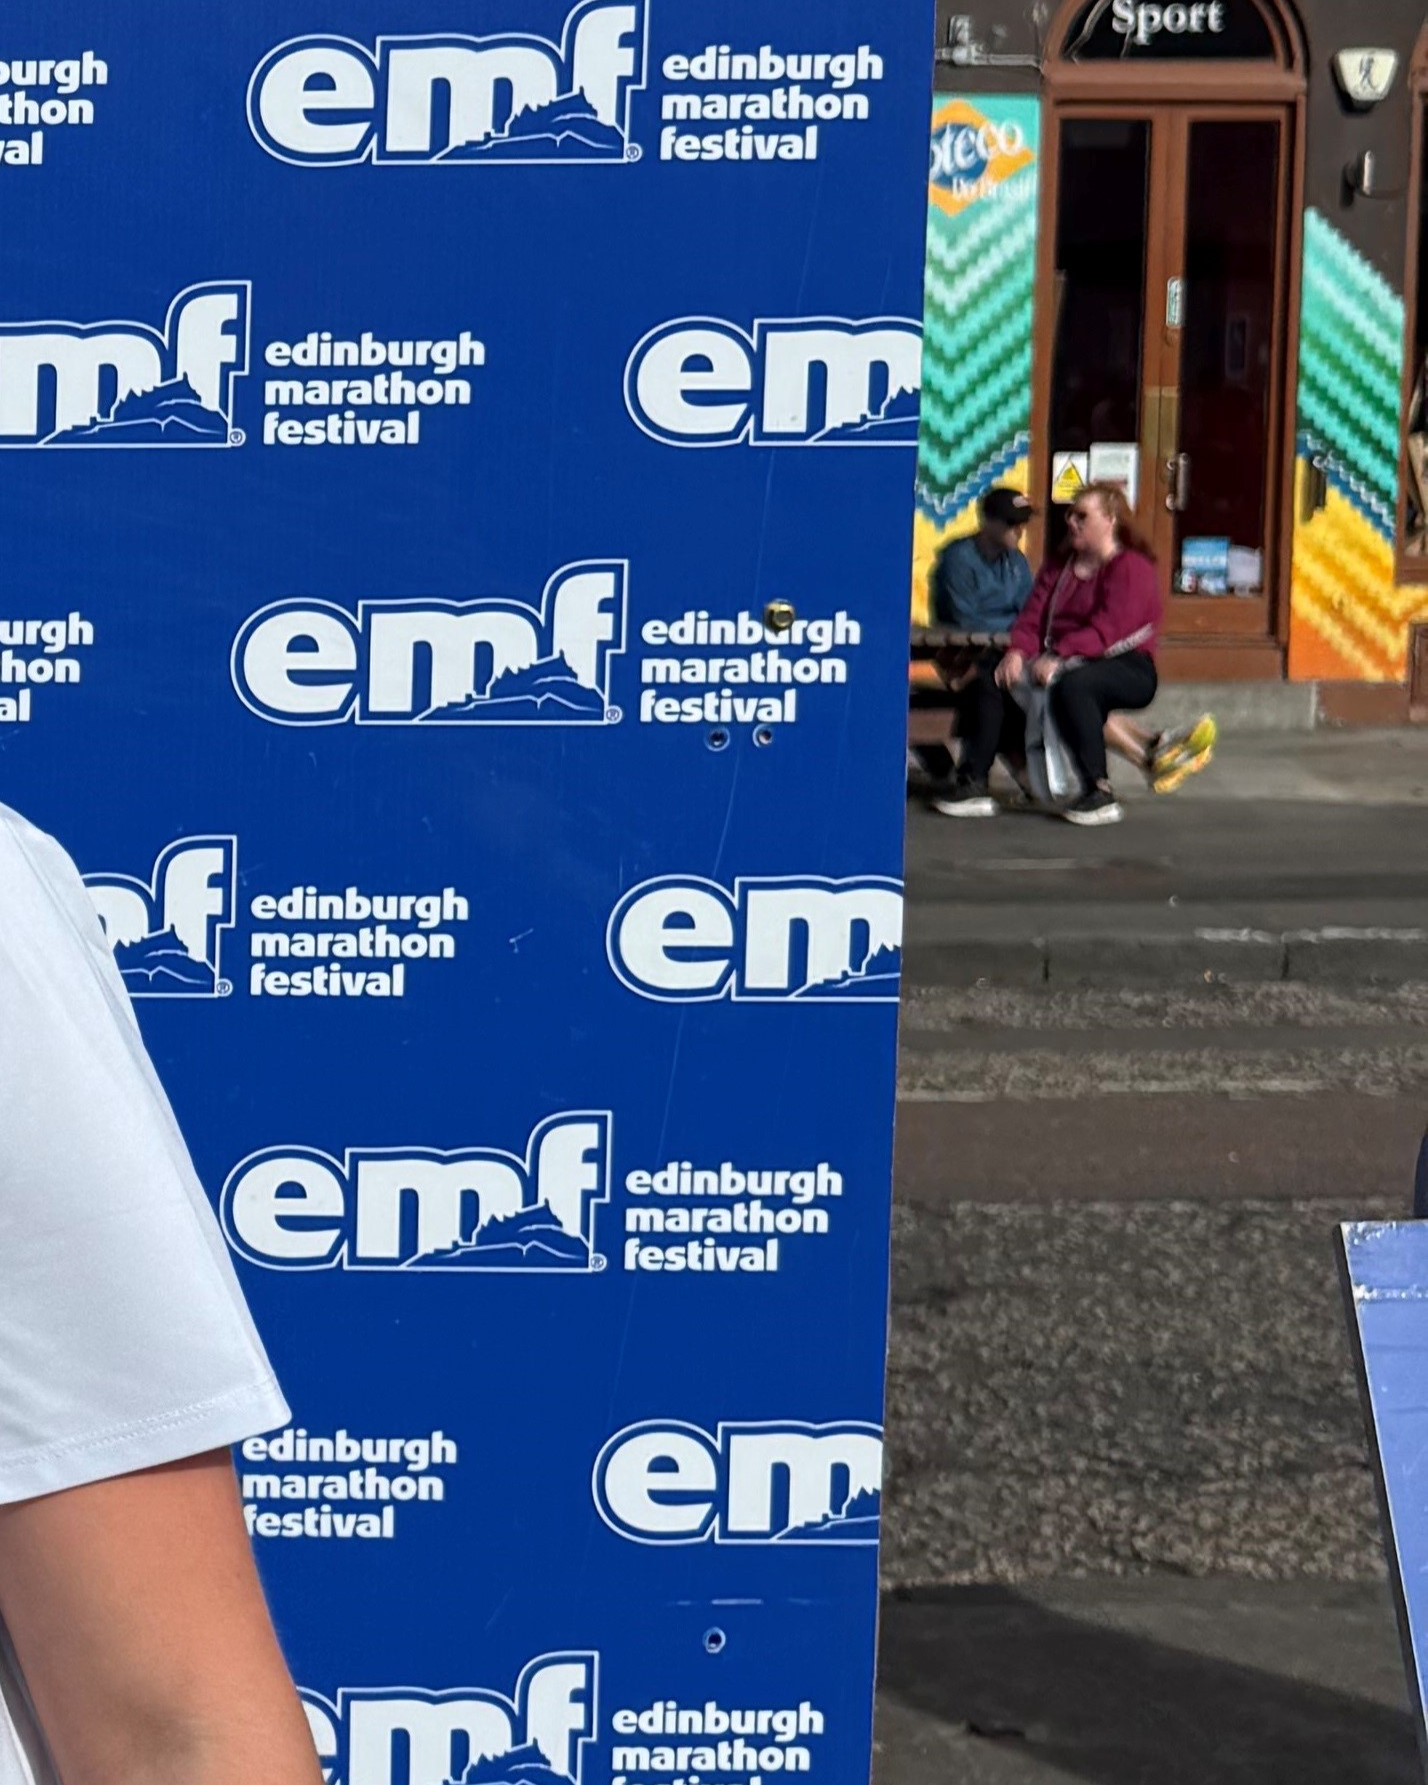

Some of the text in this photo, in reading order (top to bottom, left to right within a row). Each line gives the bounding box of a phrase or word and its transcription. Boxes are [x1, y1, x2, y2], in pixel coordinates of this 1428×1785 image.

[253, 0, 642, 160] emf
[662, 44, 884, 89] edinburgh
[661, 84, 869, 120] marathon
[660, 124, 818, 161] festival
[264, 331, 486, 375] edinburgh
[264, 370, 471, 406] marathon
[263, 410, 420, 445] festival
[238, 566, 621, 719] emf
[641, 649, 847, 684] marathon
[640, 688, 797, 723] festival
[250, 886, 469, 929] edinburgh
[250, 924, 455, 958] marathon
[250, 962, 405, 997] festival
[227, 1117, 605, 1265] emf
[625, 1161, 843, 1205] edinburgh
[625, 1199, 829, 1234] marathon
[624, 1237, 779, 1272] festival
[242, 1428, 457, 1472] edinburgh
[241, 1466, 444, 1501] marathon
[242, 1504, 395, 1538] festival
[612, 1700, 825, 1743] edinburgh
[611, 1737, 811, 1772] marathon
